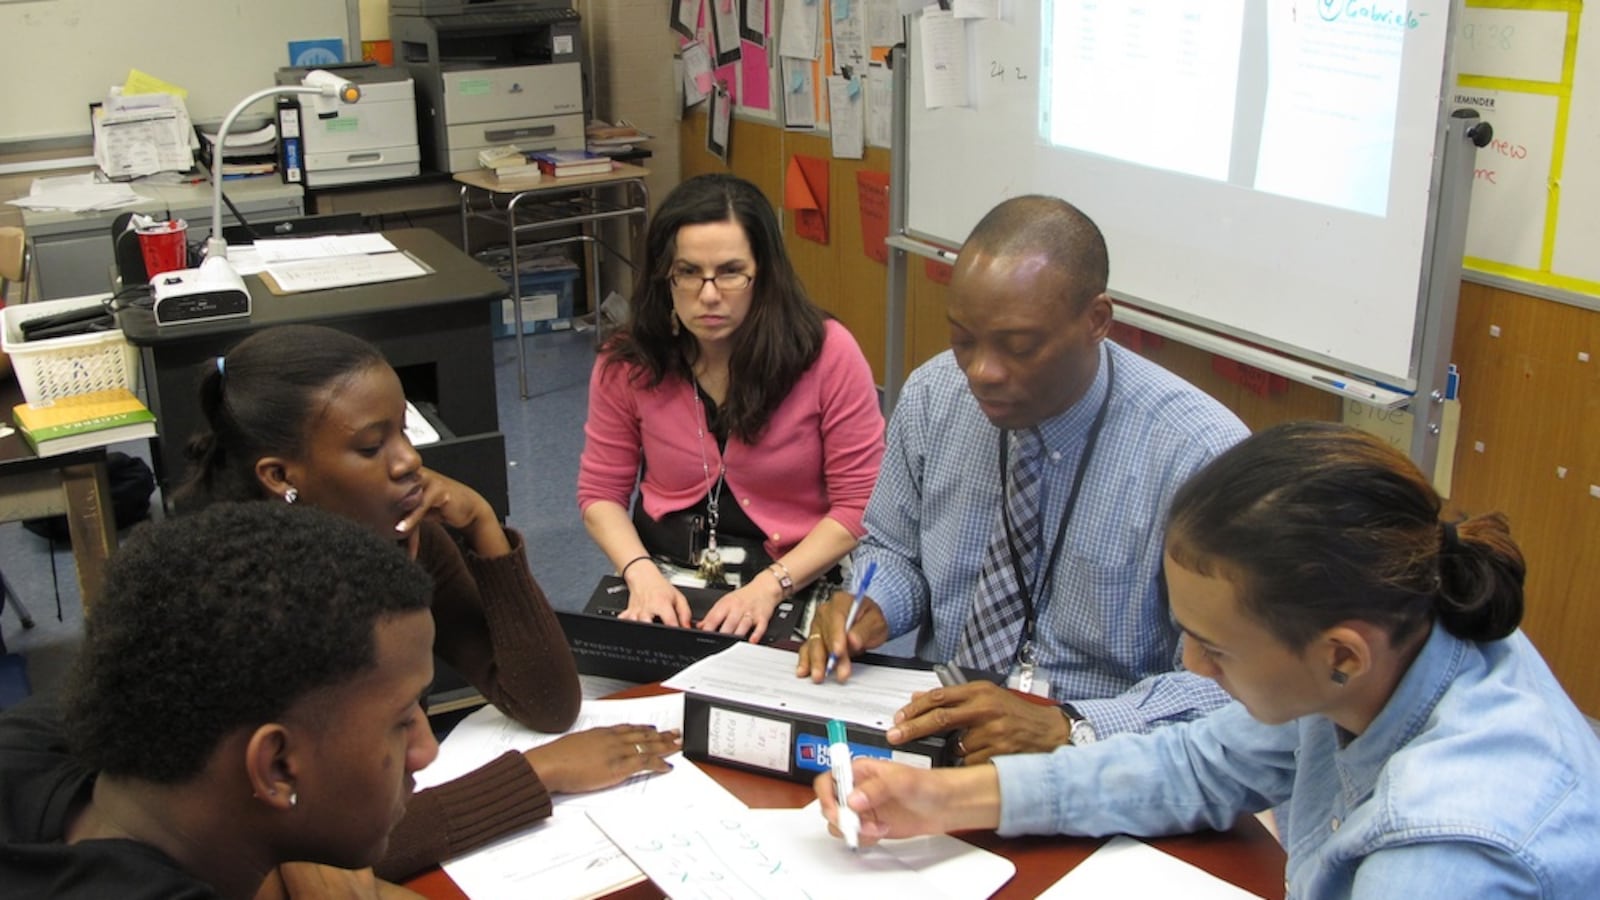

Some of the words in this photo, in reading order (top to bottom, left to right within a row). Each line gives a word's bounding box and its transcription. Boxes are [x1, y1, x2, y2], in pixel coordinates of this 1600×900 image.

[1490, 138, 1528, 160] new
[573, 638, 633, 655] Property
[635, 647, 651, 657] of
[653, 651, 676, 661] the
[644, 657, 659, 665] of
